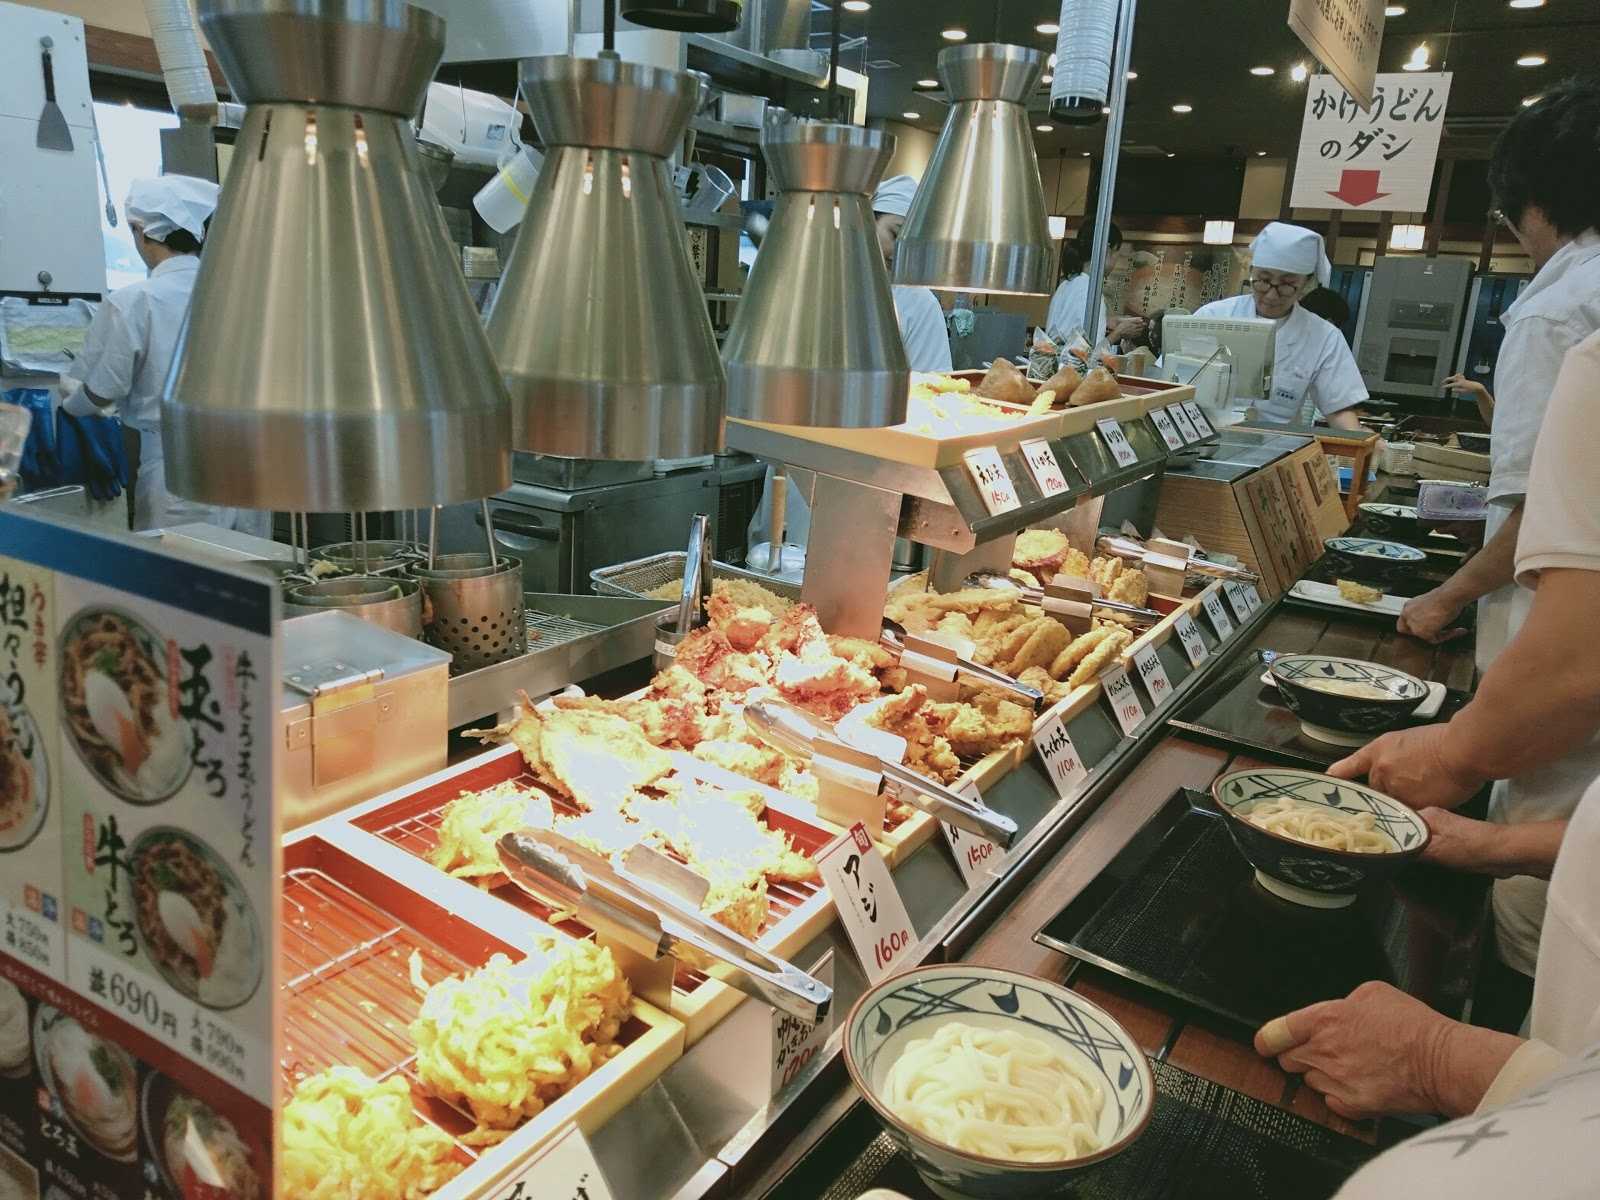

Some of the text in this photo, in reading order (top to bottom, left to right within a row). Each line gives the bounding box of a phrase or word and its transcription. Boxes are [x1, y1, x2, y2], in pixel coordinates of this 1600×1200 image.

[1312, 87, 1442, 124] かけうどん
[1320, 128, 1414, 161] のダシ
[178, 643, 227, 799] 玉とろ
[1039, 726, 1070, 760] ちくわ天
[1056, 757, 1075, 782] 110円
[966, 841, 993, 870] 150円
[94, 814, 138, 957] 牛とろ
[843, 854, 877, 923] アジ
[874, 929, 909, 969] 160円
